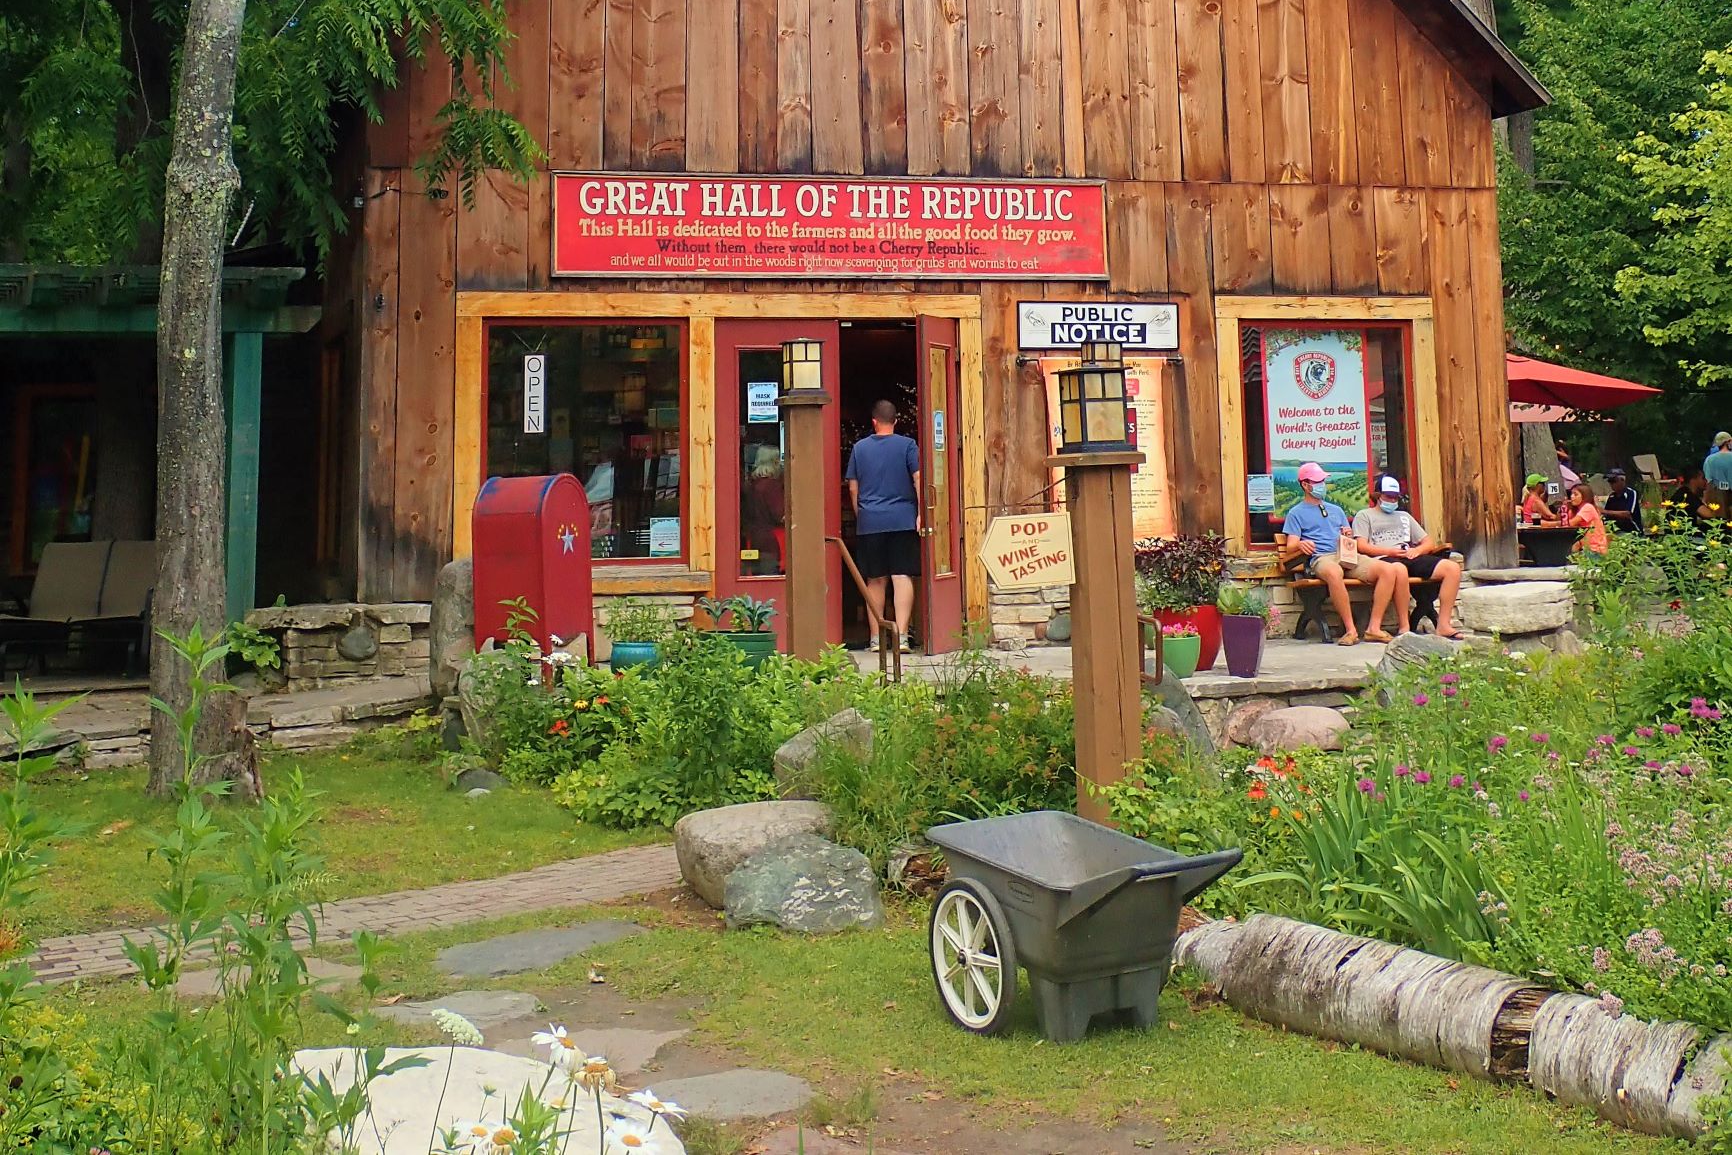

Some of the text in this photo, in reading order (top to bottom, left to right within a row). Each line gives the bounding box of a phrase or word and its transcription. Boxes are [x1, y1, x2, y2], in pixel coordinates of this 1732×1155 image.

[578, 180, 1074, 221] GREAT HALL OF THE REPUBLIC
[578, 218, 1077, 246] This Hall is dedicated to the farmers and all the good food they grow.
[656, 239, 711, 253] Without
[754, 242, 786, 254] there
[788, 240, 826, 254] would
[829, 243, 850, 254] not
[853, 241, 867, 254] be
[869, 244, 876, 254] a
[879, 240, 923, 257] Cherry
[610, 252, 630, 266] and
[631, 255, 645, 266] we
[647, 254, 661, 266] all
[664, 254, 695, 267] would
[698, 254, 710, 266] be
[712, 255, 730, 267] out
[732, 255, 742, 267] in
[744, 254, 763, 267] the
[765, 254, 797, 267] woods
[799, 255, 823, 272] right
[824, 258, 845, 267] now
[846, 257, 898, 272] scavenging
[901, 258, 916, 268] for
[916, 257, 944, 272] grubs
[947, 257, 966, 269] and
[970, 258, 1005, 269] worms
[1008, 257, 1018, 269] to
[1062, 306, 1133, 322] PUBLIC
[1054, 324, 1142, 343] NOTICE
[527, 357, 541, 431] OPEN
[1278, 404, 1355, 418] Welcome to the
[1276, 421, 1361, 434] World's Greatest
[1281, 435, 1356, 450] Cherry Region!
[1010, 522, 1048, 536] POP
[998, 545, 1040, 567] WINE
[1009, 551, 1067, 581] TASTING
